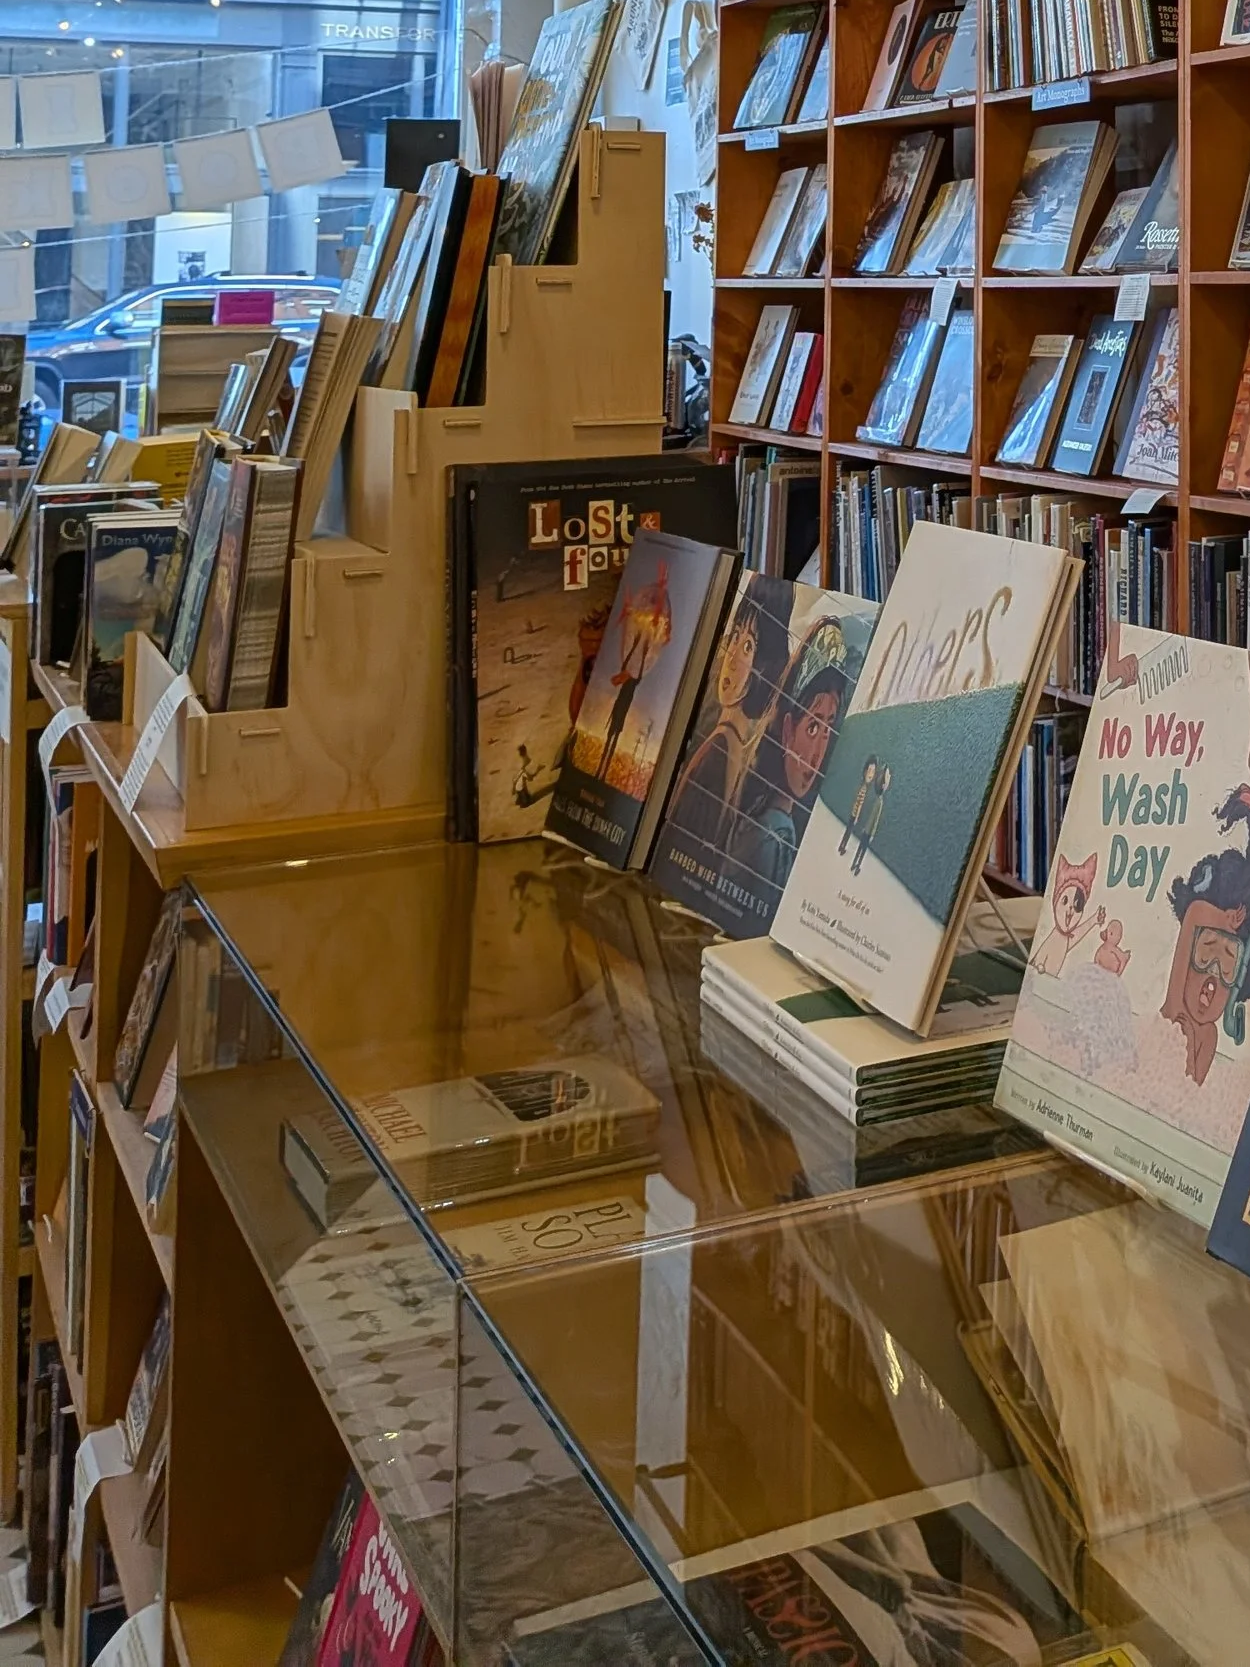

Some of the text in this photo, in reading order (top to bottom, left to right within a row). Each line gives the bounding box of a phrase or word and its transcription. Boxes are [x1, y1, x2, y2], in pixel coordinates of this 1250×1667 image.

[1047, 86, 1085, 103] Monographs
[102, 535, 139, 547] Diana
[1098, 711, 1205, 767] No Way,
[1101, 768, 1189, 827] Wash
[669, 847, 697, 875] BARBED
[697, 864, 717, 885] WIRE
[717, 872, 756, 910] BETWEEN
[756, 898, 771, 919] US
[1105, 834, 1170, 903] Day
[1035, 1098, 1094, 1142] Adrienne Thurman
[1149, 1161, 1204, 1205] Kaylani Juanita
[362, 1534, 409, 1650] SPOOKY
